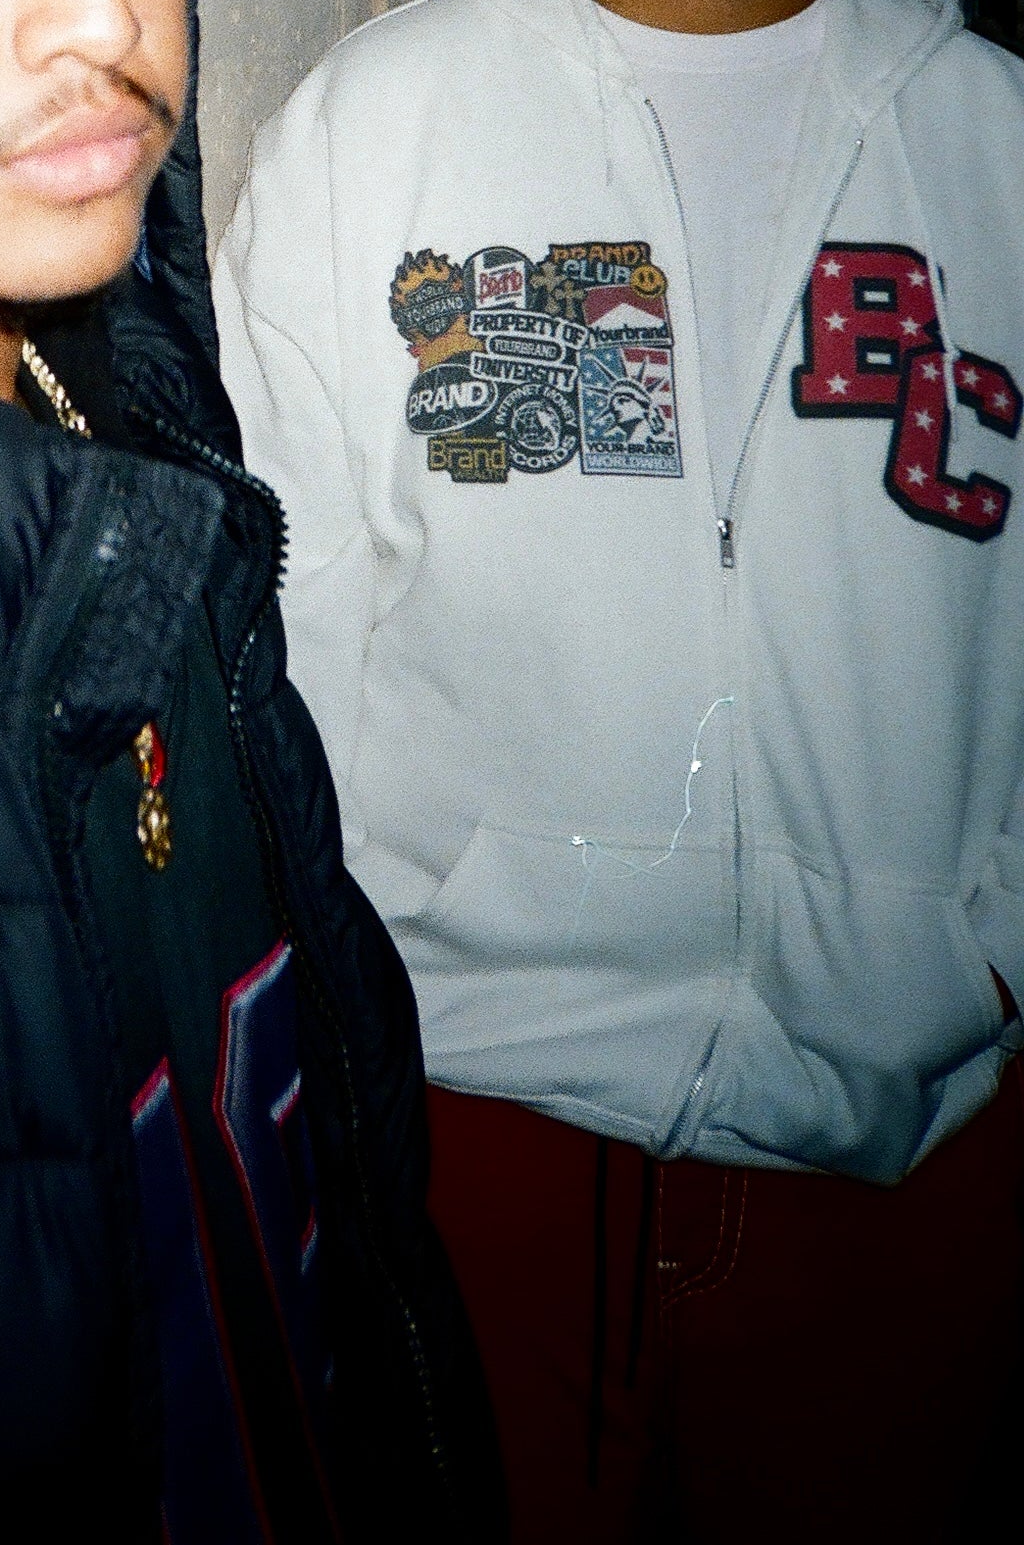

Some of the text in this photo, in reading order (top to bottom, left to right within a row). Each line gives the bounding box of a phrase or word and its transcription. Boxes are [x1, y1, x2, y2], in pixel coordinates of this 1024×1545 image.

[563, 259, 632, 284] CLUB
[473, 313, 587, 347] PROPERTY OF
[588, 321, 668, 342] Yourbrand
[473, 355, 576, 387] UNIVERSITY
[408, 381, 489, 419] BRAND
[495, 383, 578, 427] INTERNET MONEY
[790, 241, 1023, 543] BC
[429, 439, 506, 469] Brand
